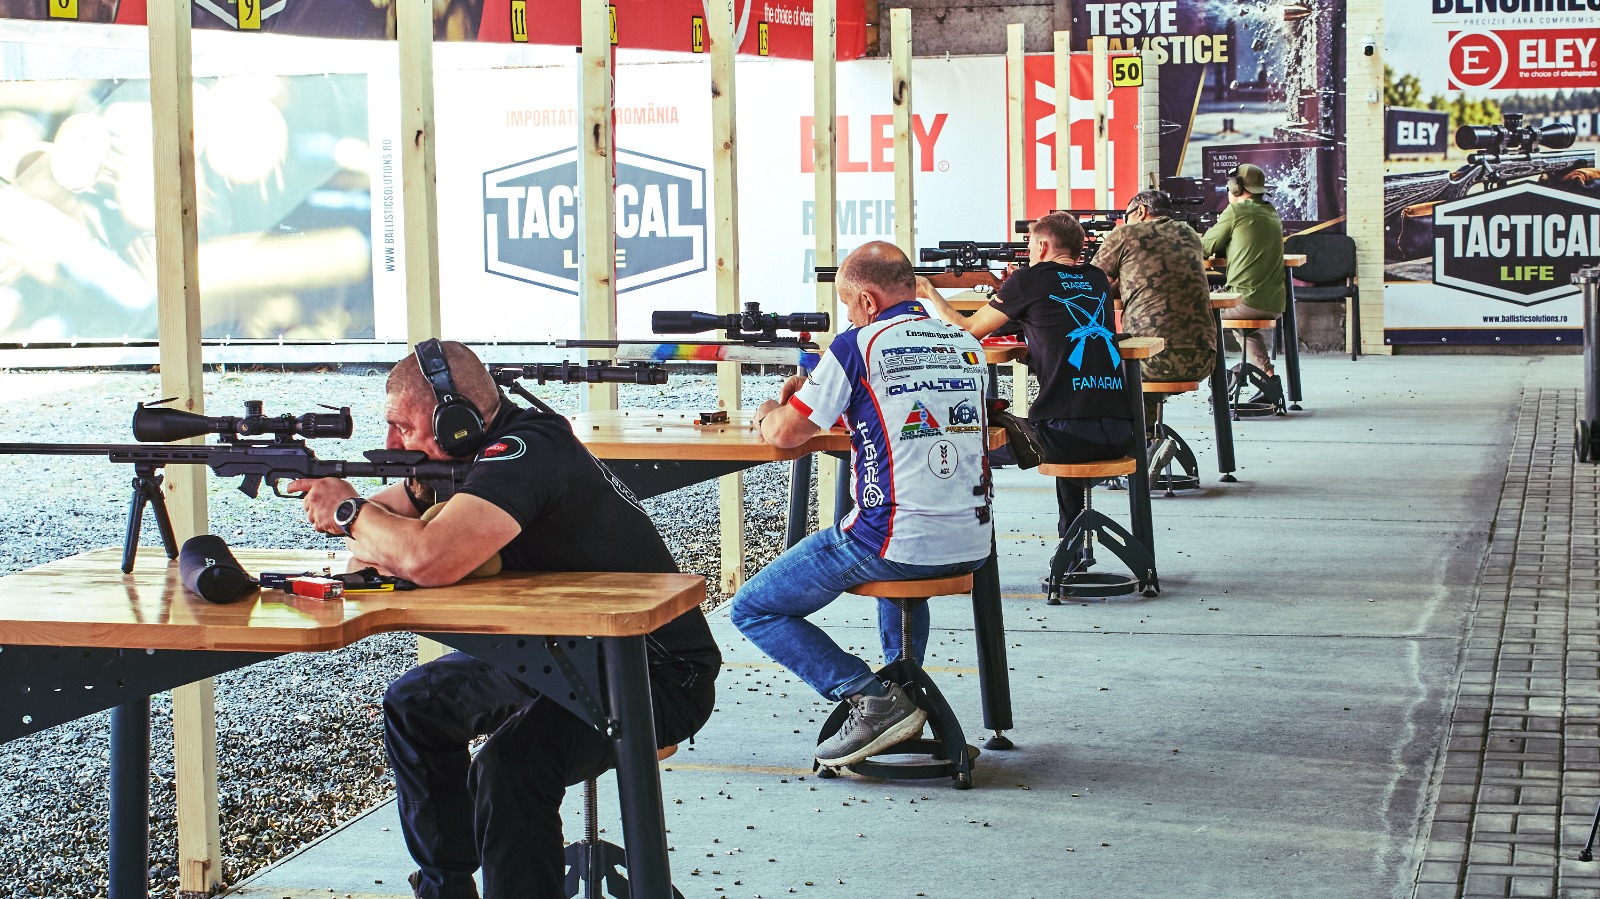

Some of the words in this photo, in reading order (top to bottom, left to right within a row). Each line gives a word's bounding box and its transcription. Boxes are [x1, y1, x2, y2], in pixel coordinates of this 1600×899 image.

[513, 8, 526, 35] 11
[763, 2, 774, 22] the
[774, 4, 793, 25] choice
[1086, 1, 1178, 35] TESTE
[1540, 16, 1595, 24] COMPROMIS
[693, 23, 703, 47] 12
[760, 30, 768, 51] 13
[1519, 38, 1597, 69] ELEY
[1115, 63, 1140, 81] 50
[1519, 70, 1530, 78] the
[1531, 70, 1552, 78] choice
[1560, 70, 1598, 78] champions
[1397, 120, 1440, 146] ELEY
[381, 139, 396, 272] WWW.BALLISTICSOLUTIONS.RO
[502, 183, 680, 239] TACCAL
[1500, 265, 1554, 281] LIFE
[1482, 314, 1568, 323] www.ballisticsolutions.ro
[884, 353, 961, 367] SERIES
[1072, 375, 1123, 391] FANARM
